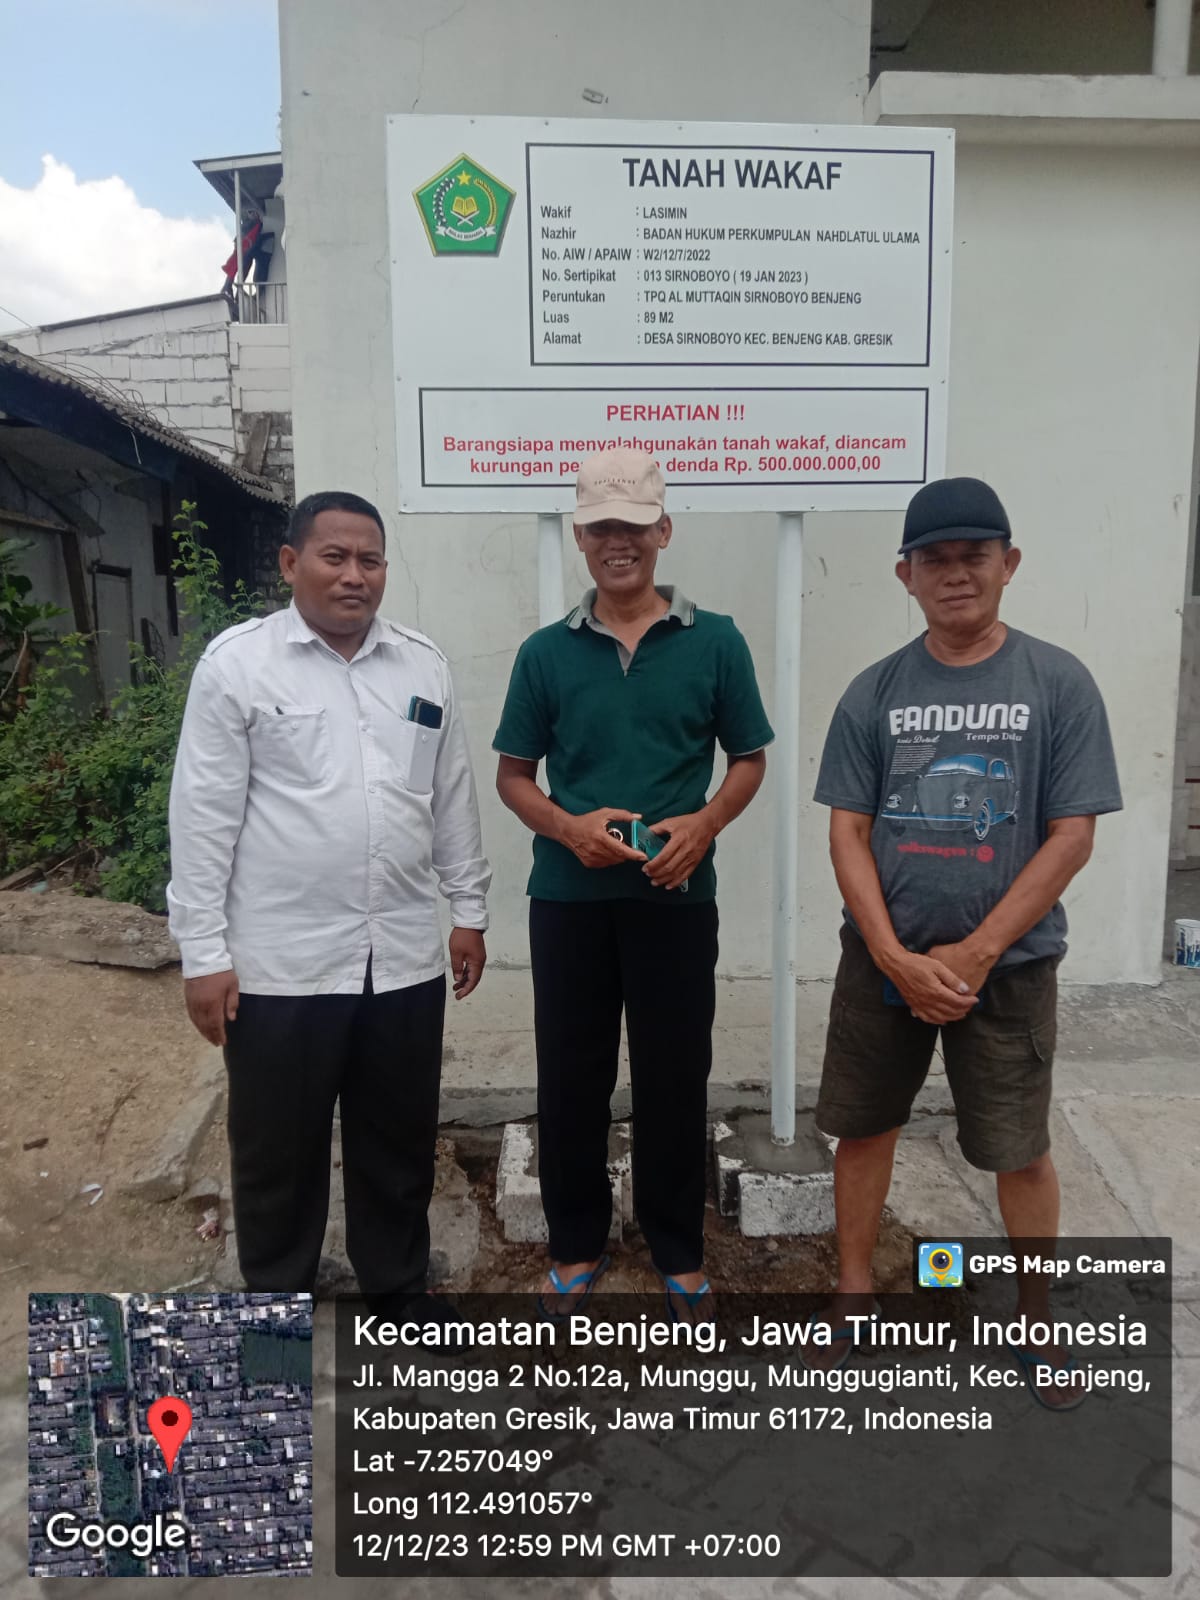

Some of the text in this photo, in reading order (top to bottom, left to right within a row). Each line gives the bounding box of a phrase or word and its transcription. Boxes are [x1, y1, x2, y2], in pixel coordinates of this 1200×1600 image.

[622, 158, 842, 190] TANAH WAKAF
[540, 205, 572, 219] Wakif
[643, 207, 688, 219] LASIMIN
[541, 226, 577, 240] Nazhir
[643, 227, 682, 241] BADAN
[685, 228, 726, 241] HUKUM
[728, 228, 811, 242] PERKUMPULAN
[816, 230, 881, 243] NAHDLATUL
[882, 231, 920, 244] ULAMA
[541, 247, 560, 261] No.
[562, 247, 586, 261] AIW
[594, 247, 632, 261] APAIW
[643, 248, 711, 261] W2/12/7/2022
[542, 268, 561, 282] No.
[563, 268, 616, 285] Sertipikat
[643, 269, 662, 282] 013
[664, 269, 730, 282] SIRNOBOYO
[740, 270, 752, 283] 19
[754, 270, 776, 283] JAN
[778, 270, 802, 283] 2023
[542, 289, 606, 303] Peruntukan
[643, 290, 666, 303] TPQ
[668, 290, 683, 303] AL
[685, 290, 741, 303] MUTTAQIN
[744, 291, 809, 304] SIRNOBOYO
[811, 291, 862, 305] BENJENG
[543, 310, 570, 324] Luas
[643, 311, 657, 324] 89
[659, 311, 674, 324] M2
[543, 331, 582, 345] Alamat
[644, 332, 674, 345] DESA
[676, 332, 742, 345] SIRNOBOYO
[744, 332, 769, 345] KEC.
[772, 332, 823, 345] BENJENG
[825, 333, 851, 345] KAB.
[853, 333, 893, 346] GRESIK
[607, 404, 746, 421] PERHATIAN !!!
[443, 436, 555, 455] Barangsiapa
[723, 435, 771, 451] tanah
[776, 435, 830, 453] wakaf,
[835, 435, 907, 450] diancam
[470, 458, 553, 477] kurungan
[666, 457, 719, 473] denda
[724, 456, 753, 475] Rp.
[758, 455, 881, 472] 500.000.000,00
[965, 732, 999, 743] Tempo
